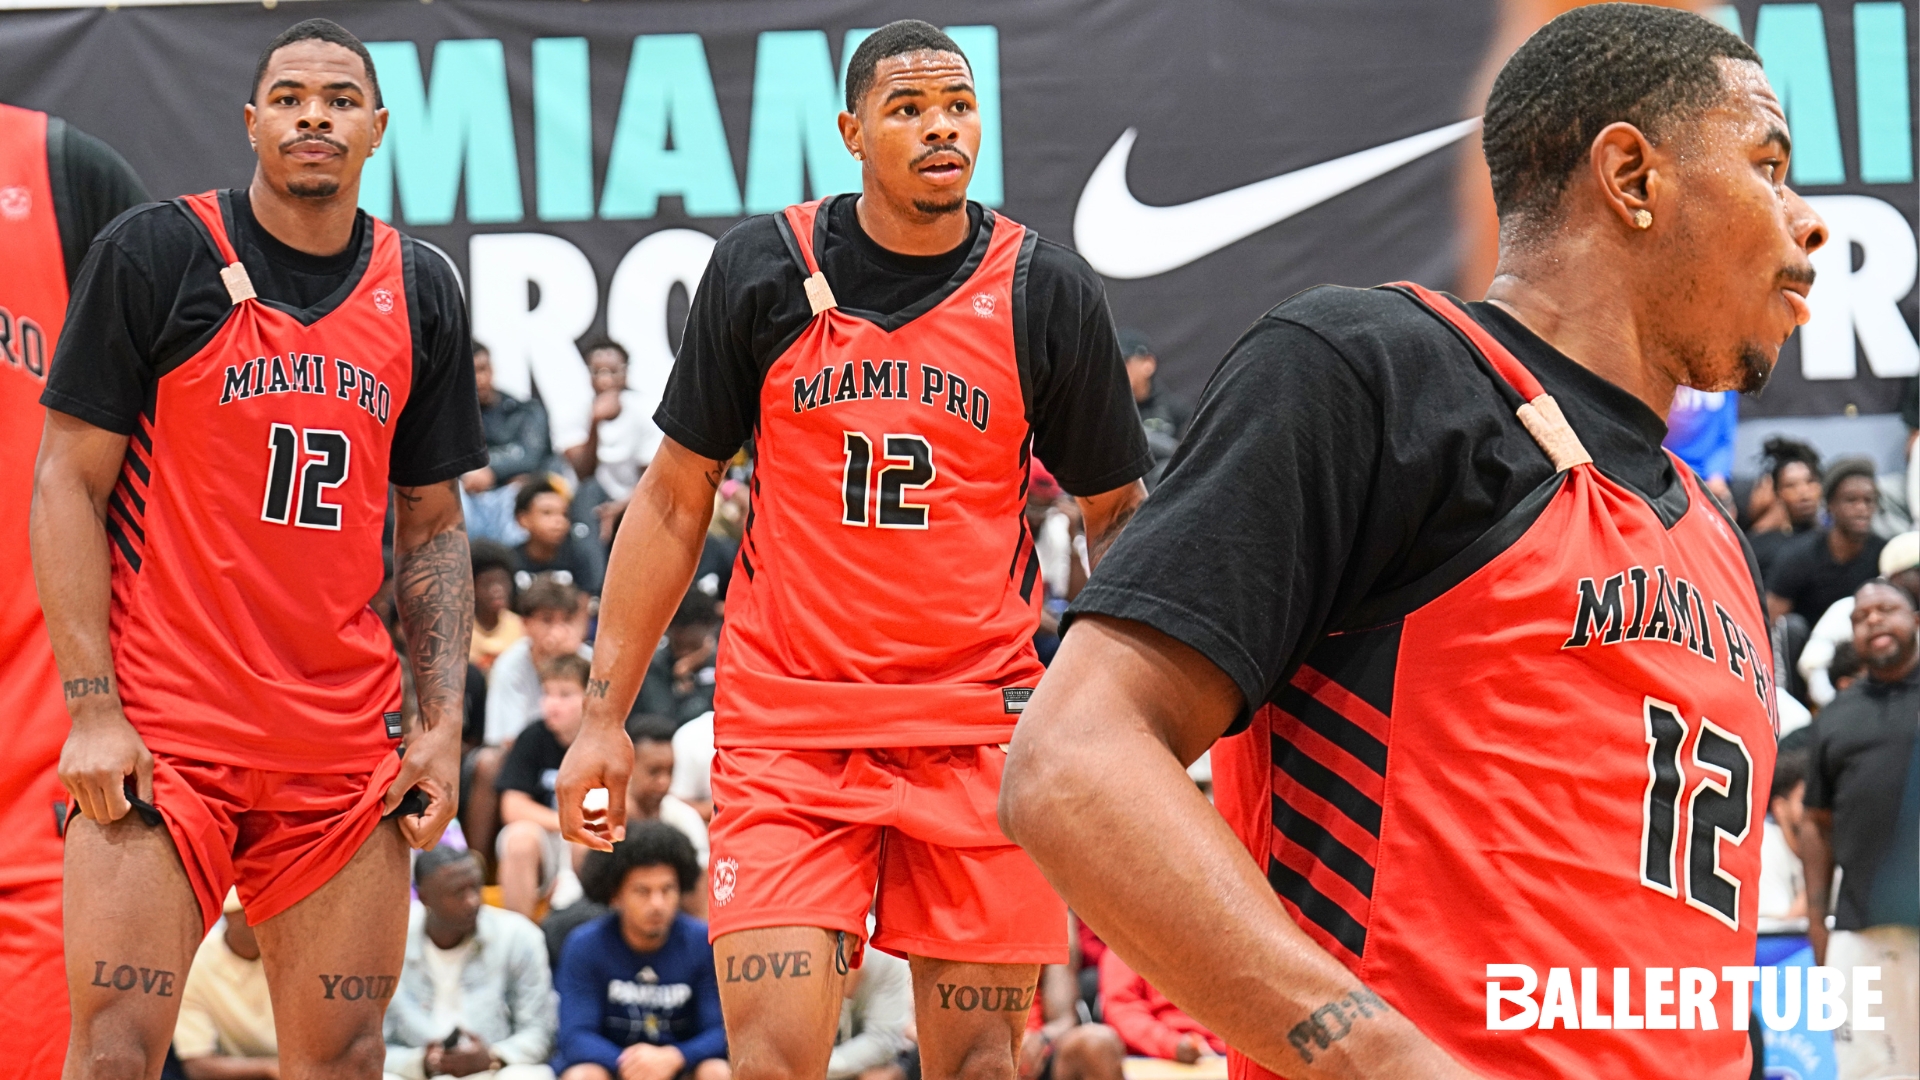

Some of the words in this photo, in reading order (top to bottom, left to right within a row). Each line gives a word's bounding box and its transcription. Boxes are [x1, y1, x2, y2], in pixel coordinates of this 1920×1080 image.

[357, 25, 1005, 226] MIAMI
[219, 352, 327, 406] MIAMI
[335, 358, 392, 428] PRO
[793, 359, 910, 415] MIAMI
[920, 363, 991, 433] PRO
[261, 422, 351, 532] 12
[842, 430, 937, 531] 12
[1561, 565, 1717, 664] MIAMI
[1640, 694, 1754, 932] 12
[91, 960, 176, 998] LOVE
[725, 950, 812, 983] LOVE
